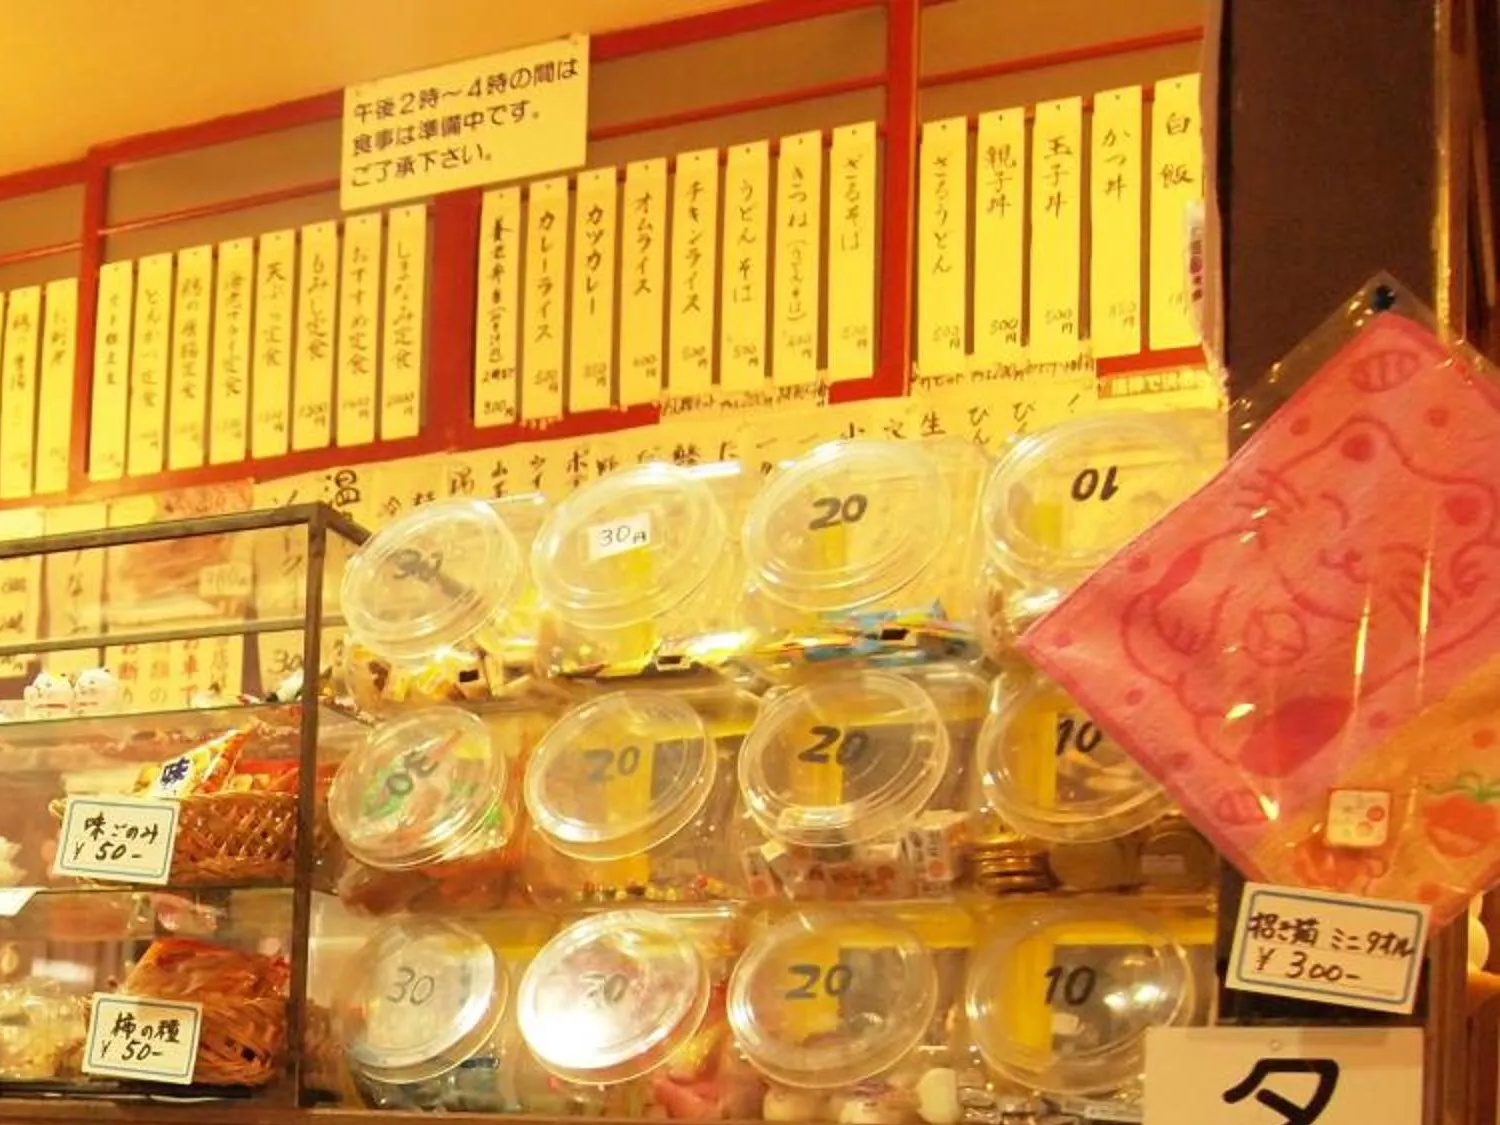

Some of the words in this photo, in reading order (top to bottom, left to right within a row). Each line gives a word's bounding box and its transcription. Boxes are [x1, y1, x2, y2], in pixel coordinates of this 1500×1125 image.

[585, 204, 604, 315] カツカレー
[634, 192, 655, 297] オムライス
[681, 181, 703, 315] チキンライス
[534, 210, 557, 343] カレーライス
[807, 495, 867, 531] 20
[600, 525, 648, 546] 30円
[798, 725, 869, 766] 20
[1055, 717, 1103, 755] 10
[161, 759, 189, 787] 味
[584, 744, 641, 783] 20
[83, 815, 159, 845] 味ごのみ
[1248, 911, 1320, 945] 招き猫
[1331, 928, 1416, 957] ミニタオル
[386, 965, 436, 1006] 30
[784, 964, 853, 1000] 20
[1044, 966, 1097, 1006] 10
[112, 1011, 182, 1044] 柿の種
